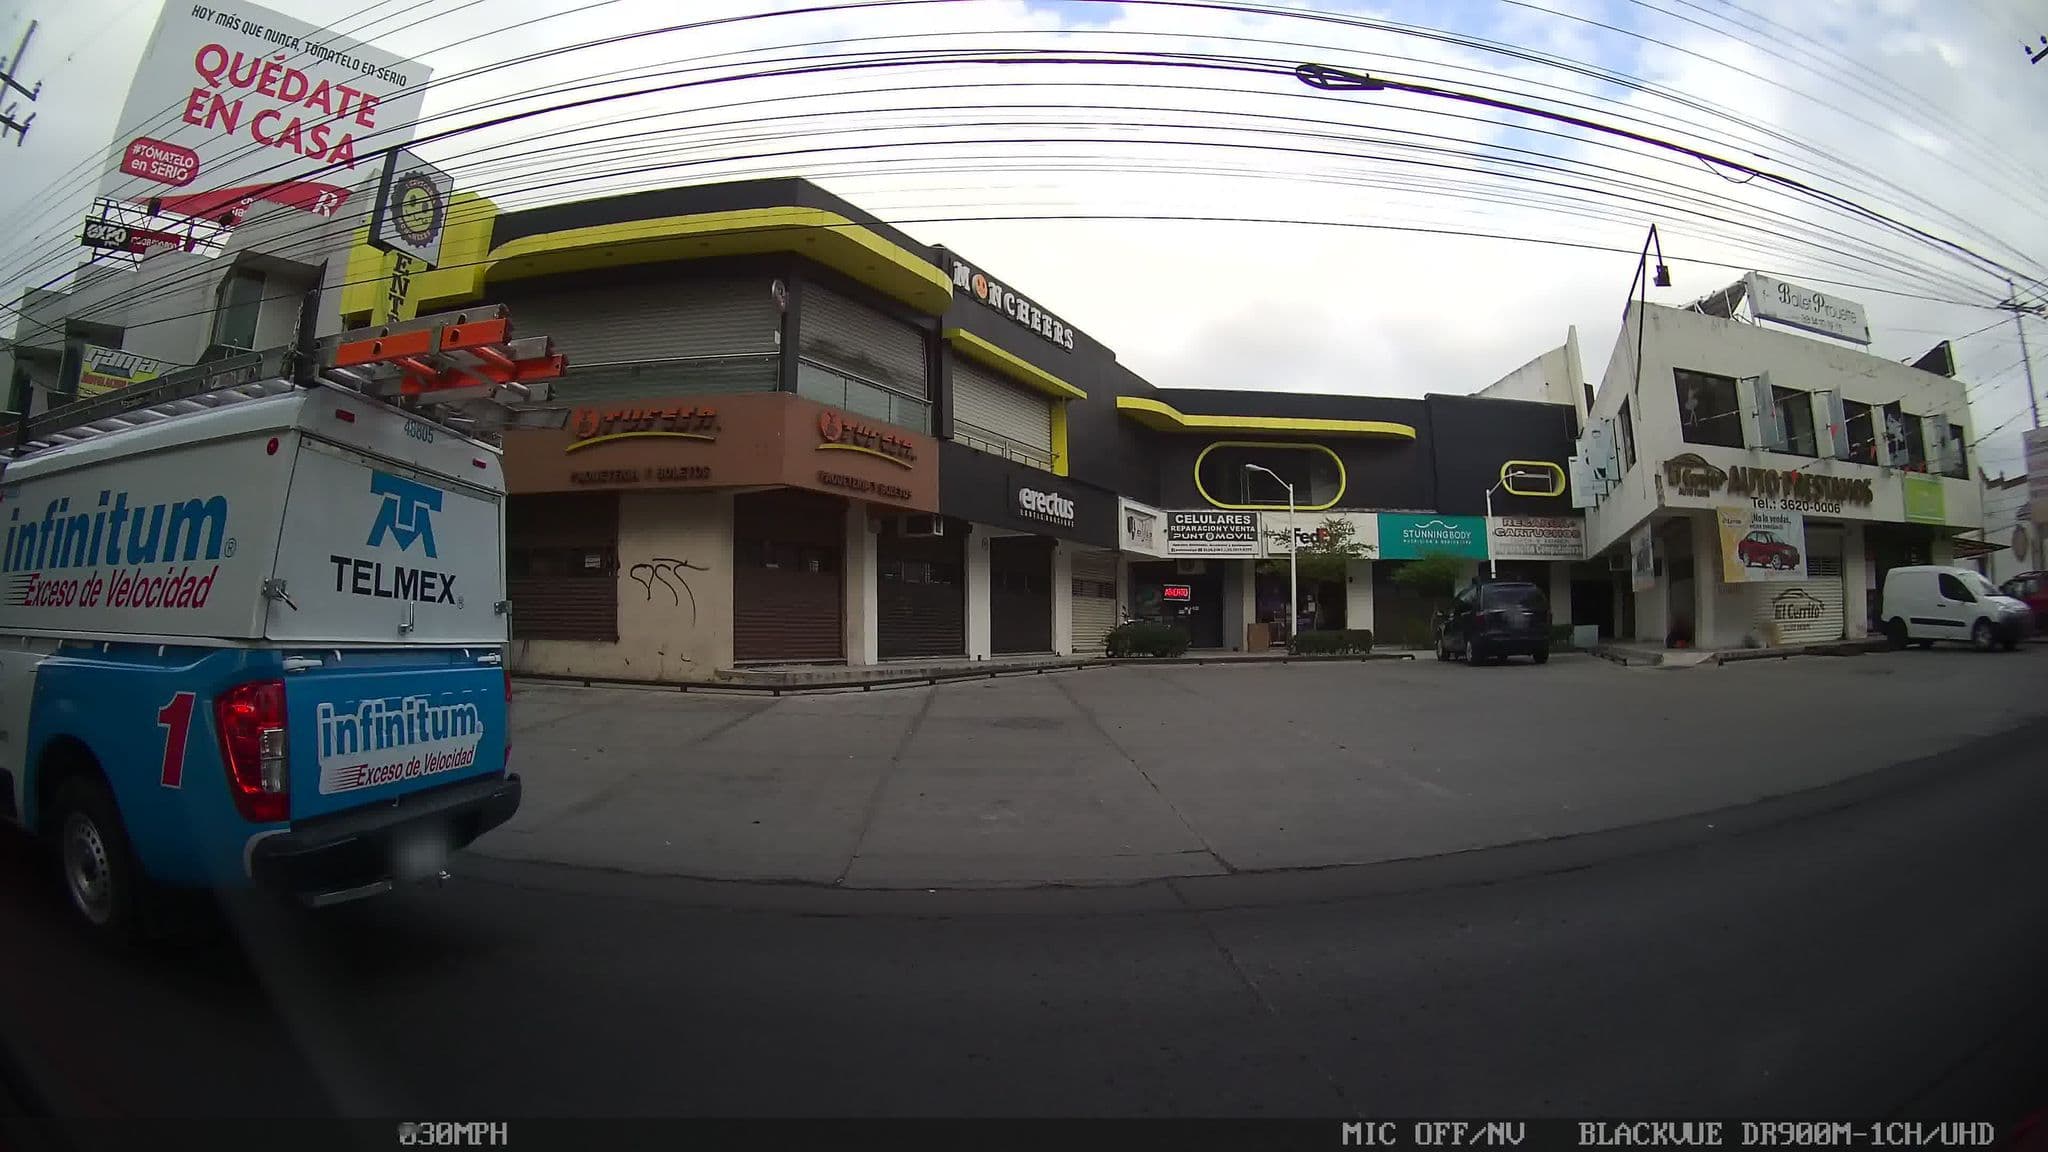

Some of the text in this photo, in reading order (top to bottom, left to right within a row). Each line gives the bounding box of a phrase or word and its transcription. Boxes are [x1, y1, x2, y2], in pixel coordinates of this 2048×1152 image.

[192, 4, 215, 21] HOY
[215, 13, 241, 30] MÁS
[241, 21, 263, 38] QUE
[305, 41, 360, 71] TÓMATELO
[376, 68, 407, 87] SERIO
[195, 43, 381, 129] QUÉDATE
[182, 87, 355, 170] EN CASA
[131, 158, 188, 181] en SERIO
[132, 143, 194, 168] #TÓMATELO
[1019, 488, 1074, 519] erectus
[1175, 514, 1251, 524] CELULARES
[1750, 497, 1841, 514] Tel.: 3620-0006
[3, 489, 228, 573] infinitum
[24, 565, 219, 608] Exceso de Velocidad
[330, 555, 456, 605] TELMEX
[157, 692, 196, 789] 1
[321, 698, 477, 758] infinitum
[356, 746, 475, 786] Exceso de Velocidad
